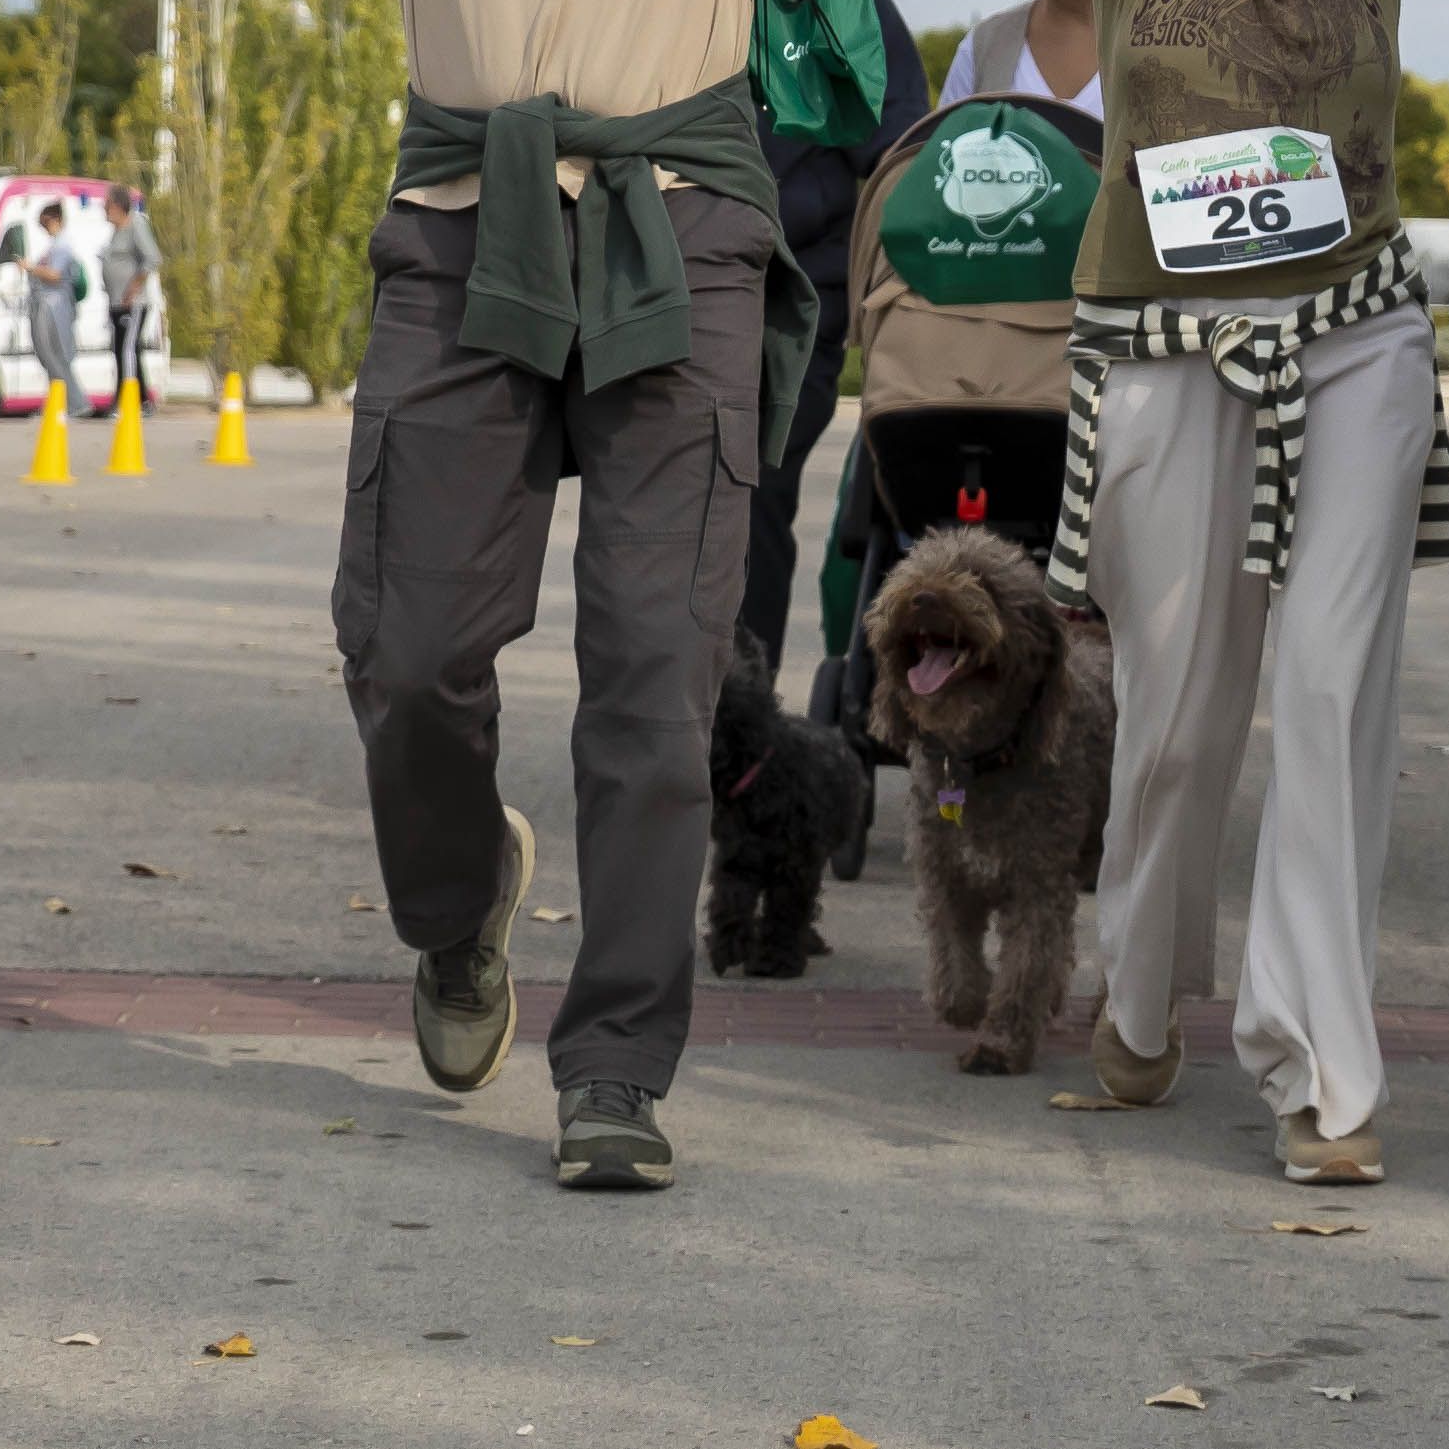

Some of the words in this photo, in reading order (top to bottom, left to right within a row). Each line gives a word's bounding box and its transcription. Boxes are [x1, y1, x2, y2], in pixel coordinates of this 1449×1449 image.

[1280, 152, 1314, 161] DOLOR
[963, 169, 1042, 184] DOLOR
[1207, 188, 1292, 240] 26
